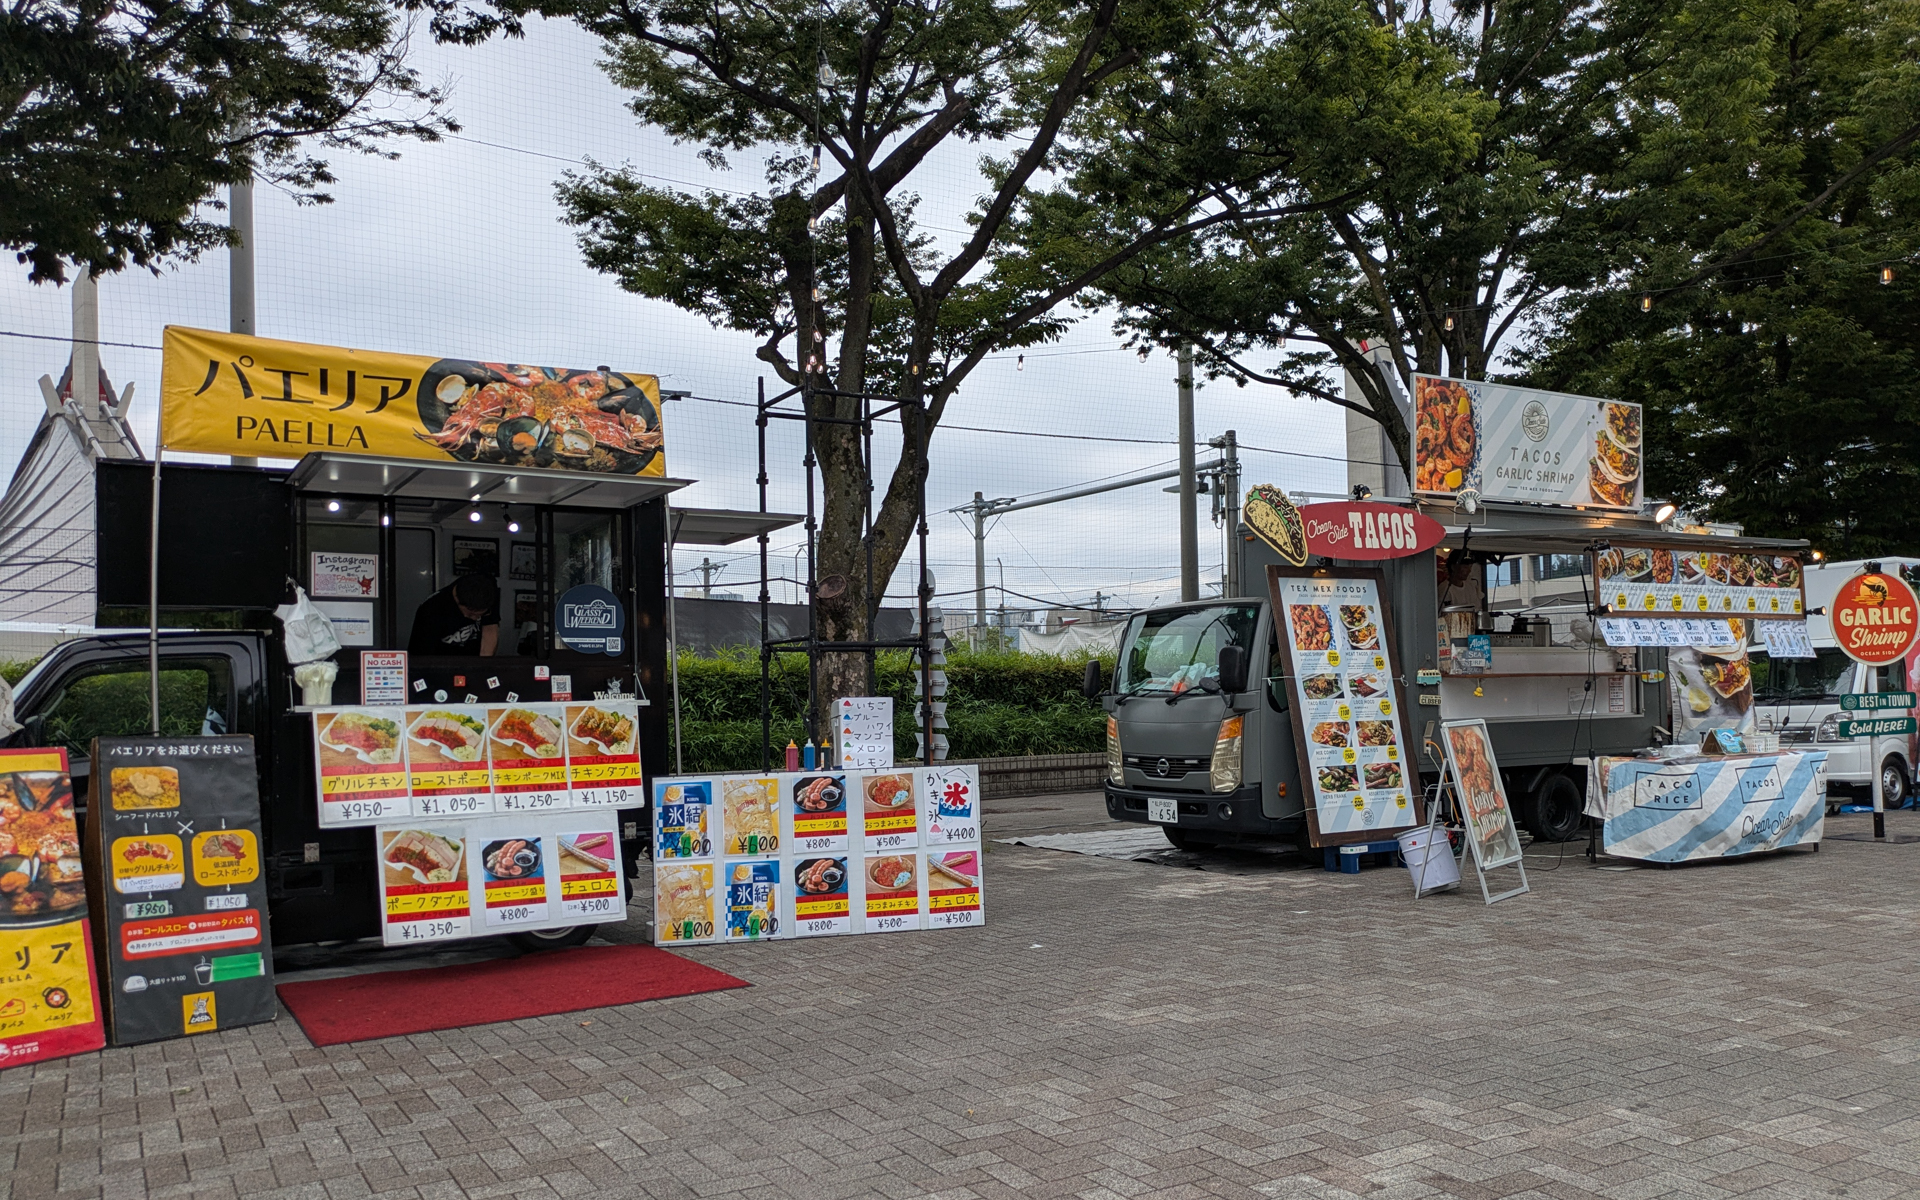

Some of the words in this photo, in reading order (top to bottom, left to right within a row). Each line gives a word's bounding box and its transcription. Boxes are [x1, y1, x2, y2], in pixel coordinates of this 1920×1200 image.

[195, 355, 412, 415] パエリア
[236, 415, 370, 449] PAELLA
[1511, 446, 1561, 466] TACOS
[1496, 467, 1533, 481] GARLIC
[1536, 470, 1575, 485] SHRIMP
[1307, 519, 1334, 539] Ocean
[1327, 524, 1349, 544] Side
[1348, 511, 1418, 550] TACOS
[317, 555, 375, 566] Instagram
[1313, 585, 1332, 593] MEX
[574, 605, 603, 616] GLASSY
[1839, 606, 1912, 627] GARLIC
[571, 613, 611, 628] WEEKEND
[1606, 620, 1613, 630] A
[1633, 621, 1640, 630] B
[1660, 621, 1667, 630] C
[1685, 622, 1692, 630] D
[1710, 622, 1717, 630] E
[1470, 637, 1489, 648] Aloha
[1849, 627, 1908, 649] Shrimp
[593, 691, 635, 700] Welcome
[1859, 695, 1879, 708] BEST
[1879, 698, 1887, 706] IN
[1887, 694, 1911, 707] TOWN
[857, 701, 886, 711] いちご
[867, 722, 892, 731] ハワイ
[1848, 721, 1873, 735] Sold
[1874, 719, 1908, 734] HERE!
[854, 732, 892, 741] マンゴー
[110, 744, 243, 757] パエリアをお選びください
[857, 744, 886, 753] メロン
[857, 758, 887, 767] レモン
[493, 770, 566, 783] チキンポークMIX
[571, 765, 640, 779] チキンダブル
[328, 776, 403, 792] グリルチキン
[411, 772, 490, 787] ローストポーク
[1647, 779, 1692, 790] TACO
[1746, 778, 1775, 790] TACOS
[504, 793, 560, 809] ¥1,250-
[582, 789, 634, 804] ¥1,150-
[926, 772, 943, 823] かき氷
[943, 782, 969, 806] 氷
[1471, 787, 1497, 813] GARLIC
[1654, 795, 1690, 804] RICE
[342, 802, 392, 819] ¥950-
[421, 797, 485, 814] ¥1,050-
[115, 811, 180, 821] シーフードパエリア
[668, 806, 701, 825] 氷結
[794, 820, 847, 830] ソーセージ盛り
[865, 818, 916, 829] おつまみチキン
[1476, 811, 1504, 839] SHRIMP
[1741, 815, 1771, 838] Ocean
[1771, 811, 1794, 835] Side
[946, 827, 976, 841] ¥400
[672, 838, 712, 856] ¥600
[738, 836, 778, 853] ¥600
[805, 838, 836, 849] ¥800-
[876, 836, 906, 848] ¥500-
[200, 867, 254, 879] ローストポーク
[485, 886, 545, 900] ソーセージ盛り
[563, 879, 615, 895] チュロス
[737, 885, 769, 904] 氷結
[930, 893, 978, 908] チュロス
[387, 894, 468, 911] ポークダブル
[580, 898, 609, 913] ¥500
[796, 901, 848, 912] ソーセージ盛り
[866, 900, 918, 910] おつまみチキン
[137, 904, 166, 916] ¥950
[500, 907, 535, 921] ¥800-
[877, 917, 908, 929] ¥500-
[945, 912, 971, 924] ¥500
[401, 920, 461, 940] ¥1,350-
[672, 921, 713, 939] ¥600
[739, 918, 779, 936] ¥600
[808, 920, 838, 932] ¥800-
